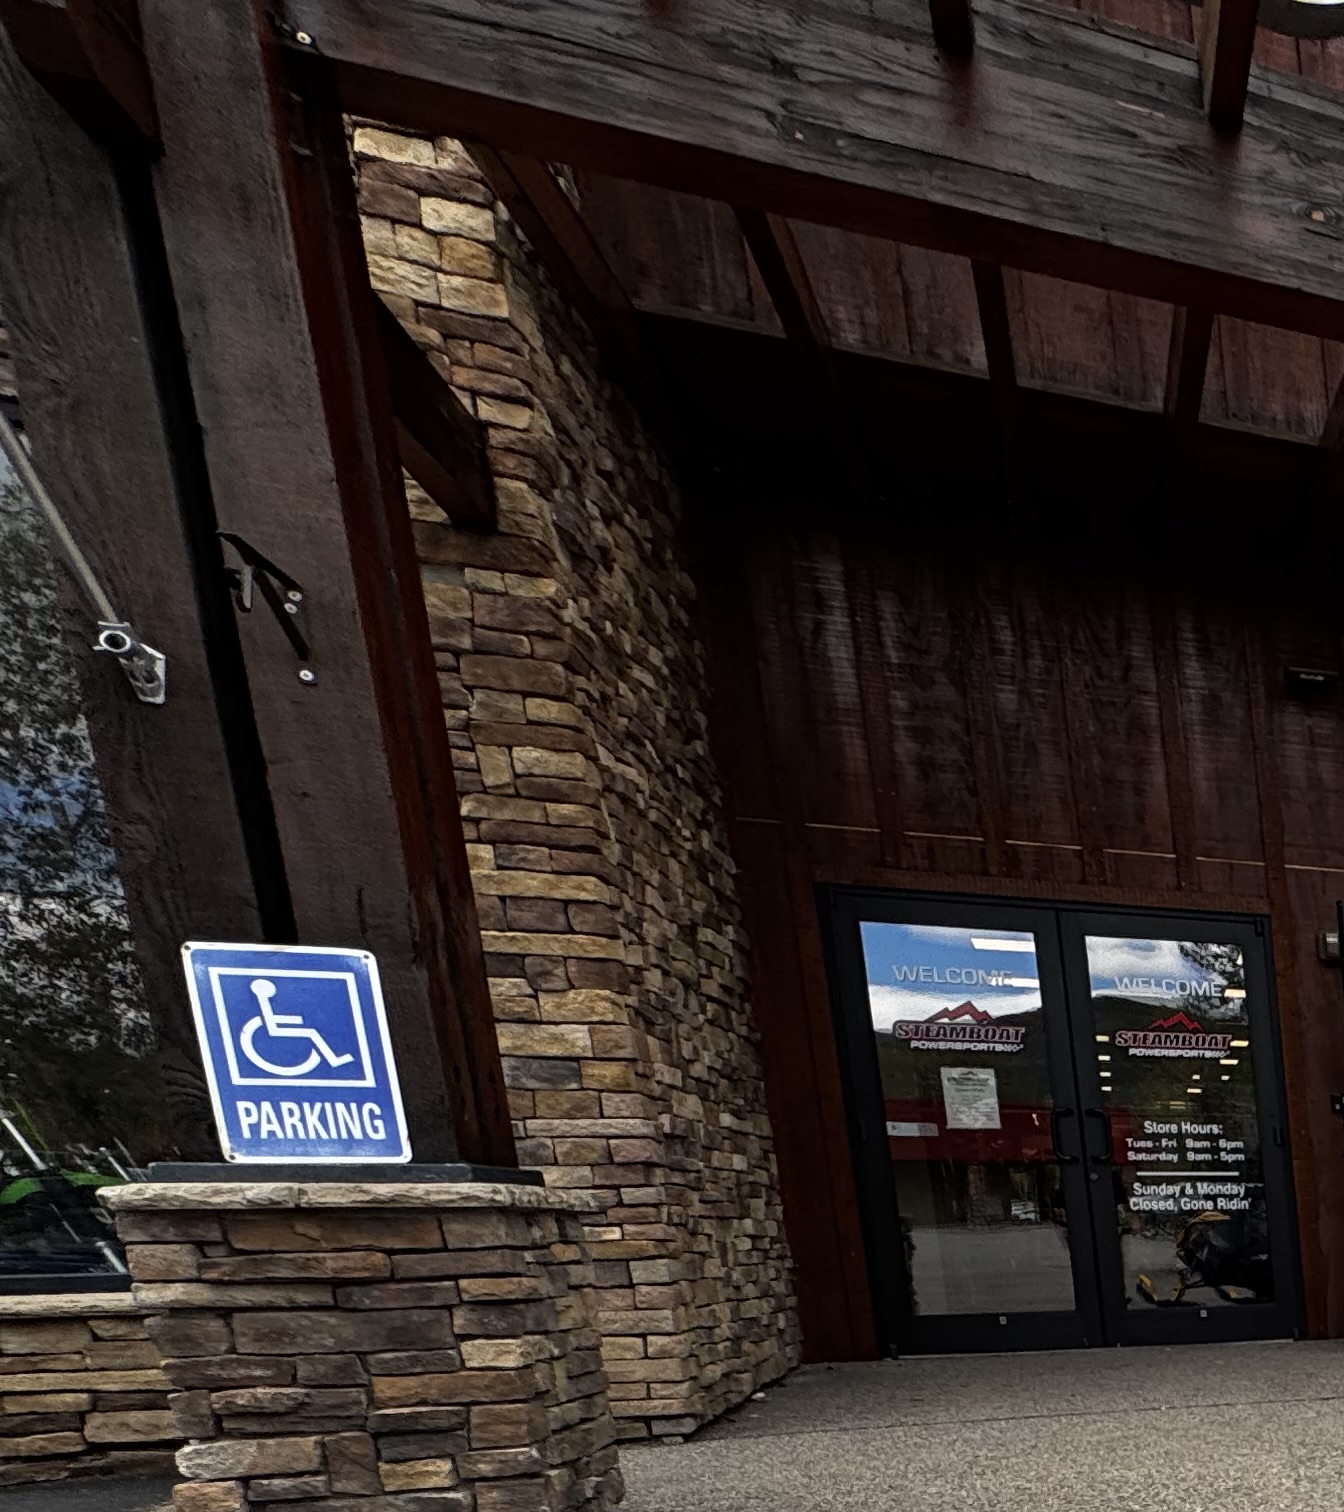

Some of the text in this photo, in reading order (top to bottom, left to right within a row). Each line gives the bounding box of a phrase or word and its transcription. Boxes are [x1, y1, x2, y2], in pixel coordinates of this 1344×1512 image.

[891, 964, 1013, 987] WELCOME
[1114, 976, 1223, 997] WELCOME
[895, 1022, 1026, 1043] STEAMBOAT
[1114, 1029, 1232, 1050] STEAMBOAT
[910, 1040, 1004, 1052] POWERSPORTS
[1128, 1047, 1214, 1059] POWERSPORTS
[236, 1100, 387, 1142] PARKING
[1143, 1120, 1223, 1135] Store Hours:
[1125, 1138, 1153, 1148] Tues
[1161, 1138, 1177, 1148] Fri
[1185, 1138, 1211, 1149] 9am
[1127, 1151, 1179, 1162] Saturday
[1186, 1151, 1212, 1161] 9am
[1220, 1151, 1245, 1163] 5pm
[1133, 1182, 1246, 1198] Sunday & Monday
[1129, 1197, 1252, 1211] Closed, Gone Ridin'
